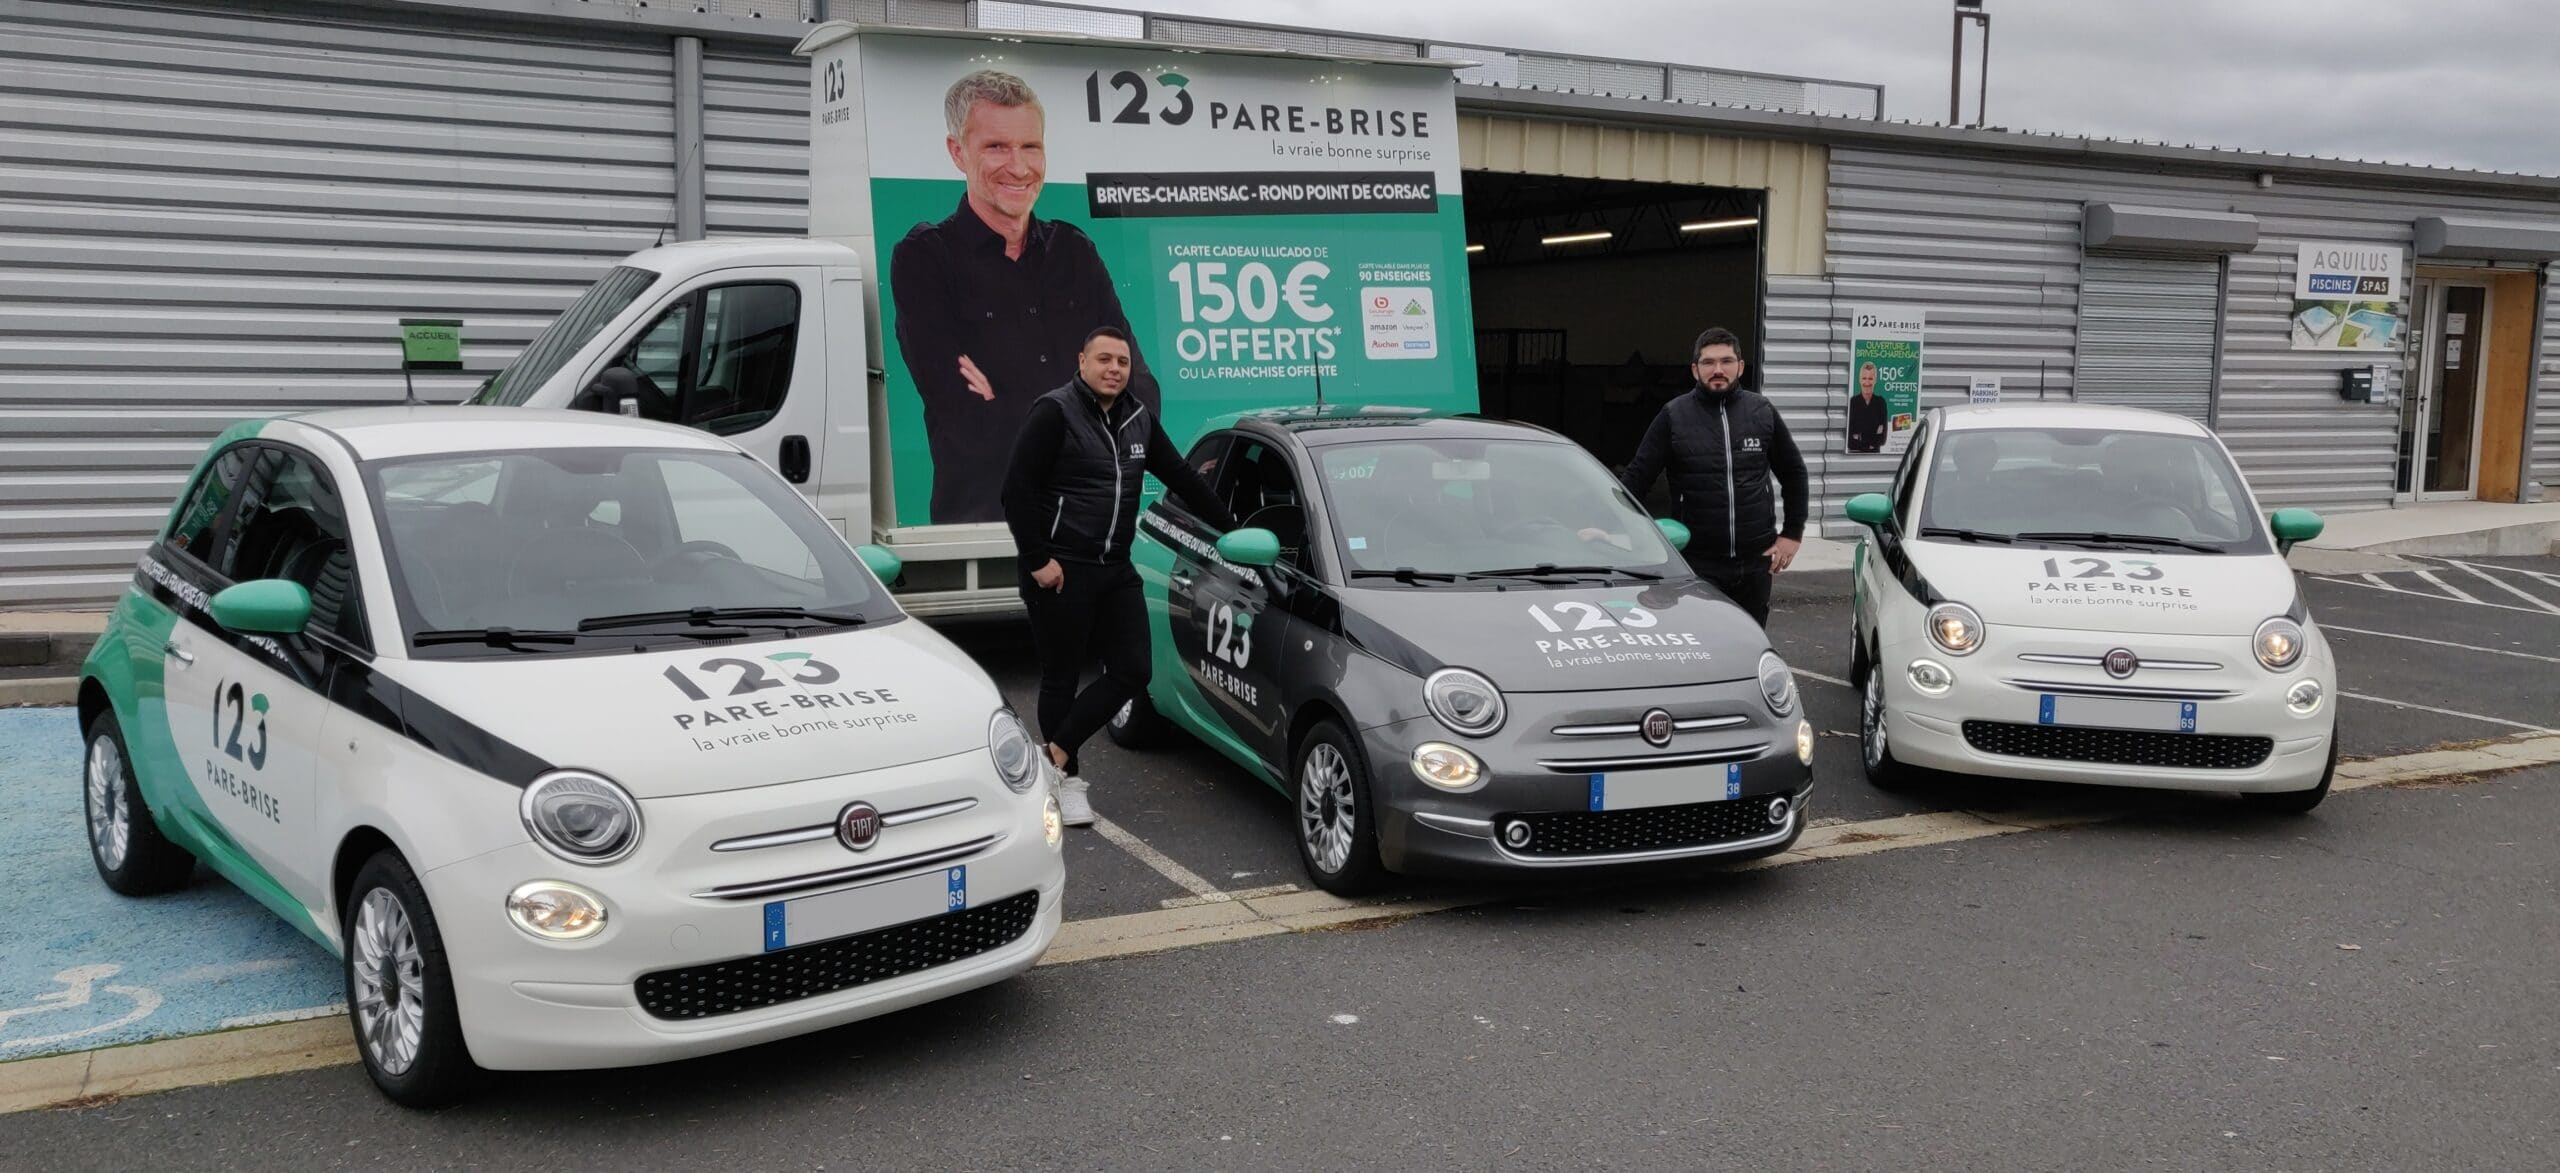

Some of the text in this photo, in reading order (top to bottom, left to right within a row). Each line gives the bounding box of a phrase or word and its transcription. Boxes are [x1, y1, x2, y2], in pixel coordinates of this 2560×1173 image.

[824, 58, 845, 104] 123
[1086, 69, 1430, 139] 123 PARE-BRISE
[1272, 139, 1432, 165] la vraie bonne surprise
[1096, 186, 1250, 204] BRIVES-CHARENSAC
[1259, 184, 1304, 202] ROND
[1306, 184, 1351, 201] POINT
[1352, 184, 1371, 200] DE
[1373, 183, 1431, 200] CORSAC
[1168, 245, 1328, 258] 1 CARTE CADEAU ILLICADO DE
[2313, 250, 2388, 272] AQUILUS
[1359, 271, 1431, 281] 90 ENSEIGNES
[1168, 260, 1335, 323] 150€
[2311, 278, 2387, 292] PISCINES SPAS
[1370, 324, 1398, 332] amazon
[1857, 315, 1920, 330] 123 PARE-BRISE
[409, 331, 454, 340] ACCUEIL
[1371, 340, 1399, 349] Auchan
[1866, 340, 1905, 350] OUVERTURE
[1179, 365, 1338, 380] OU LA FRANCHISE OFFERTE
[1884, 382, 1918, 392] OFFERTS
[1130, 443, 1144, 454] 123
[1744, 438, 1760, 447] 123
[2043, 557, 2164, 581] 123
[2028, 582, 2193, 598] PARE-BRISE
[2030, 595, 2199, 612] la vraie bonne surprise
[1528, 601, 1658, 633] 123
[1207, 601, 1253, 669] 123
[1535, 632, 1702, 654] PARE-BRISE
[1547, 648, 1712, 669] la vraie bonne surprise
[2113, 657, 2130, 670] FIAT
[663, 651, 841, 701] 123
[1201, 659, 1258, 706] PARE-BRISE
[673, 687, 900, 730] PARE-BRISE
[213, 677, 270, 771] 123
[692, 710, 918, 752] la vraie bonne surprise
[1651, 720, 1667, 736] FIAT
[2181, 718, 2194, 729] 69
[206, 759, 280, 824] PARE-BRISE
[1728, 782, 1740, 795] 38
[1594, 796, 1600, 805] F
[850, 816, 873, 839] FIAT
[949, 889, 964, 907] 69
[772, 931, 779, 942] F
